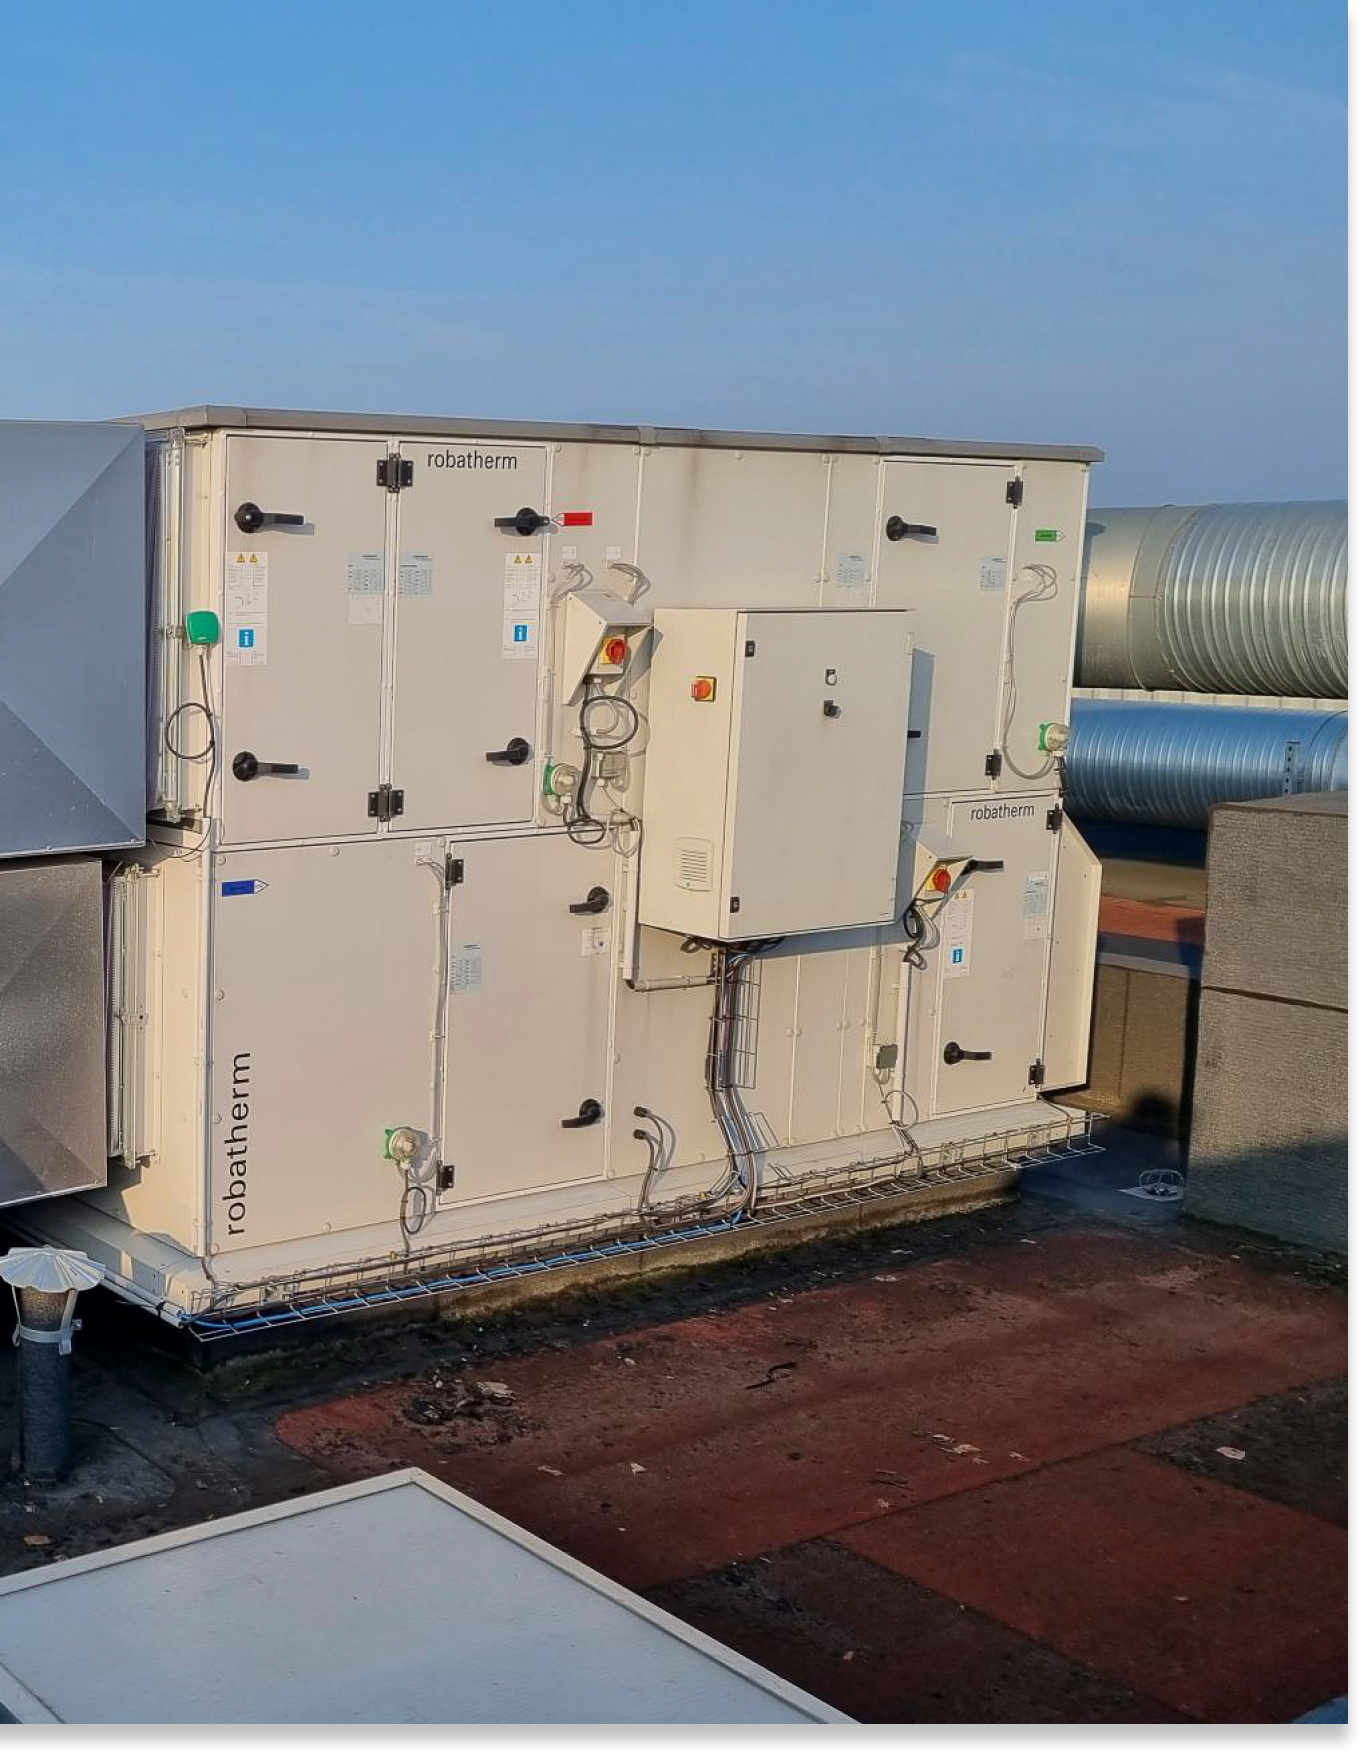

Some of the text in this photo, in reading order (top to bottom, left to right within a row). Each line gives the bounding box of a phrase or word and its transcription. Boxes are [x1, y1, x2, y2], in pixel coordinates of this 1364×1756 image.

[427, 449, 518, 470] robatherm
[970, 803, 1035, 821] robatherm
[222, 1052, 251, 1236] robatherm
